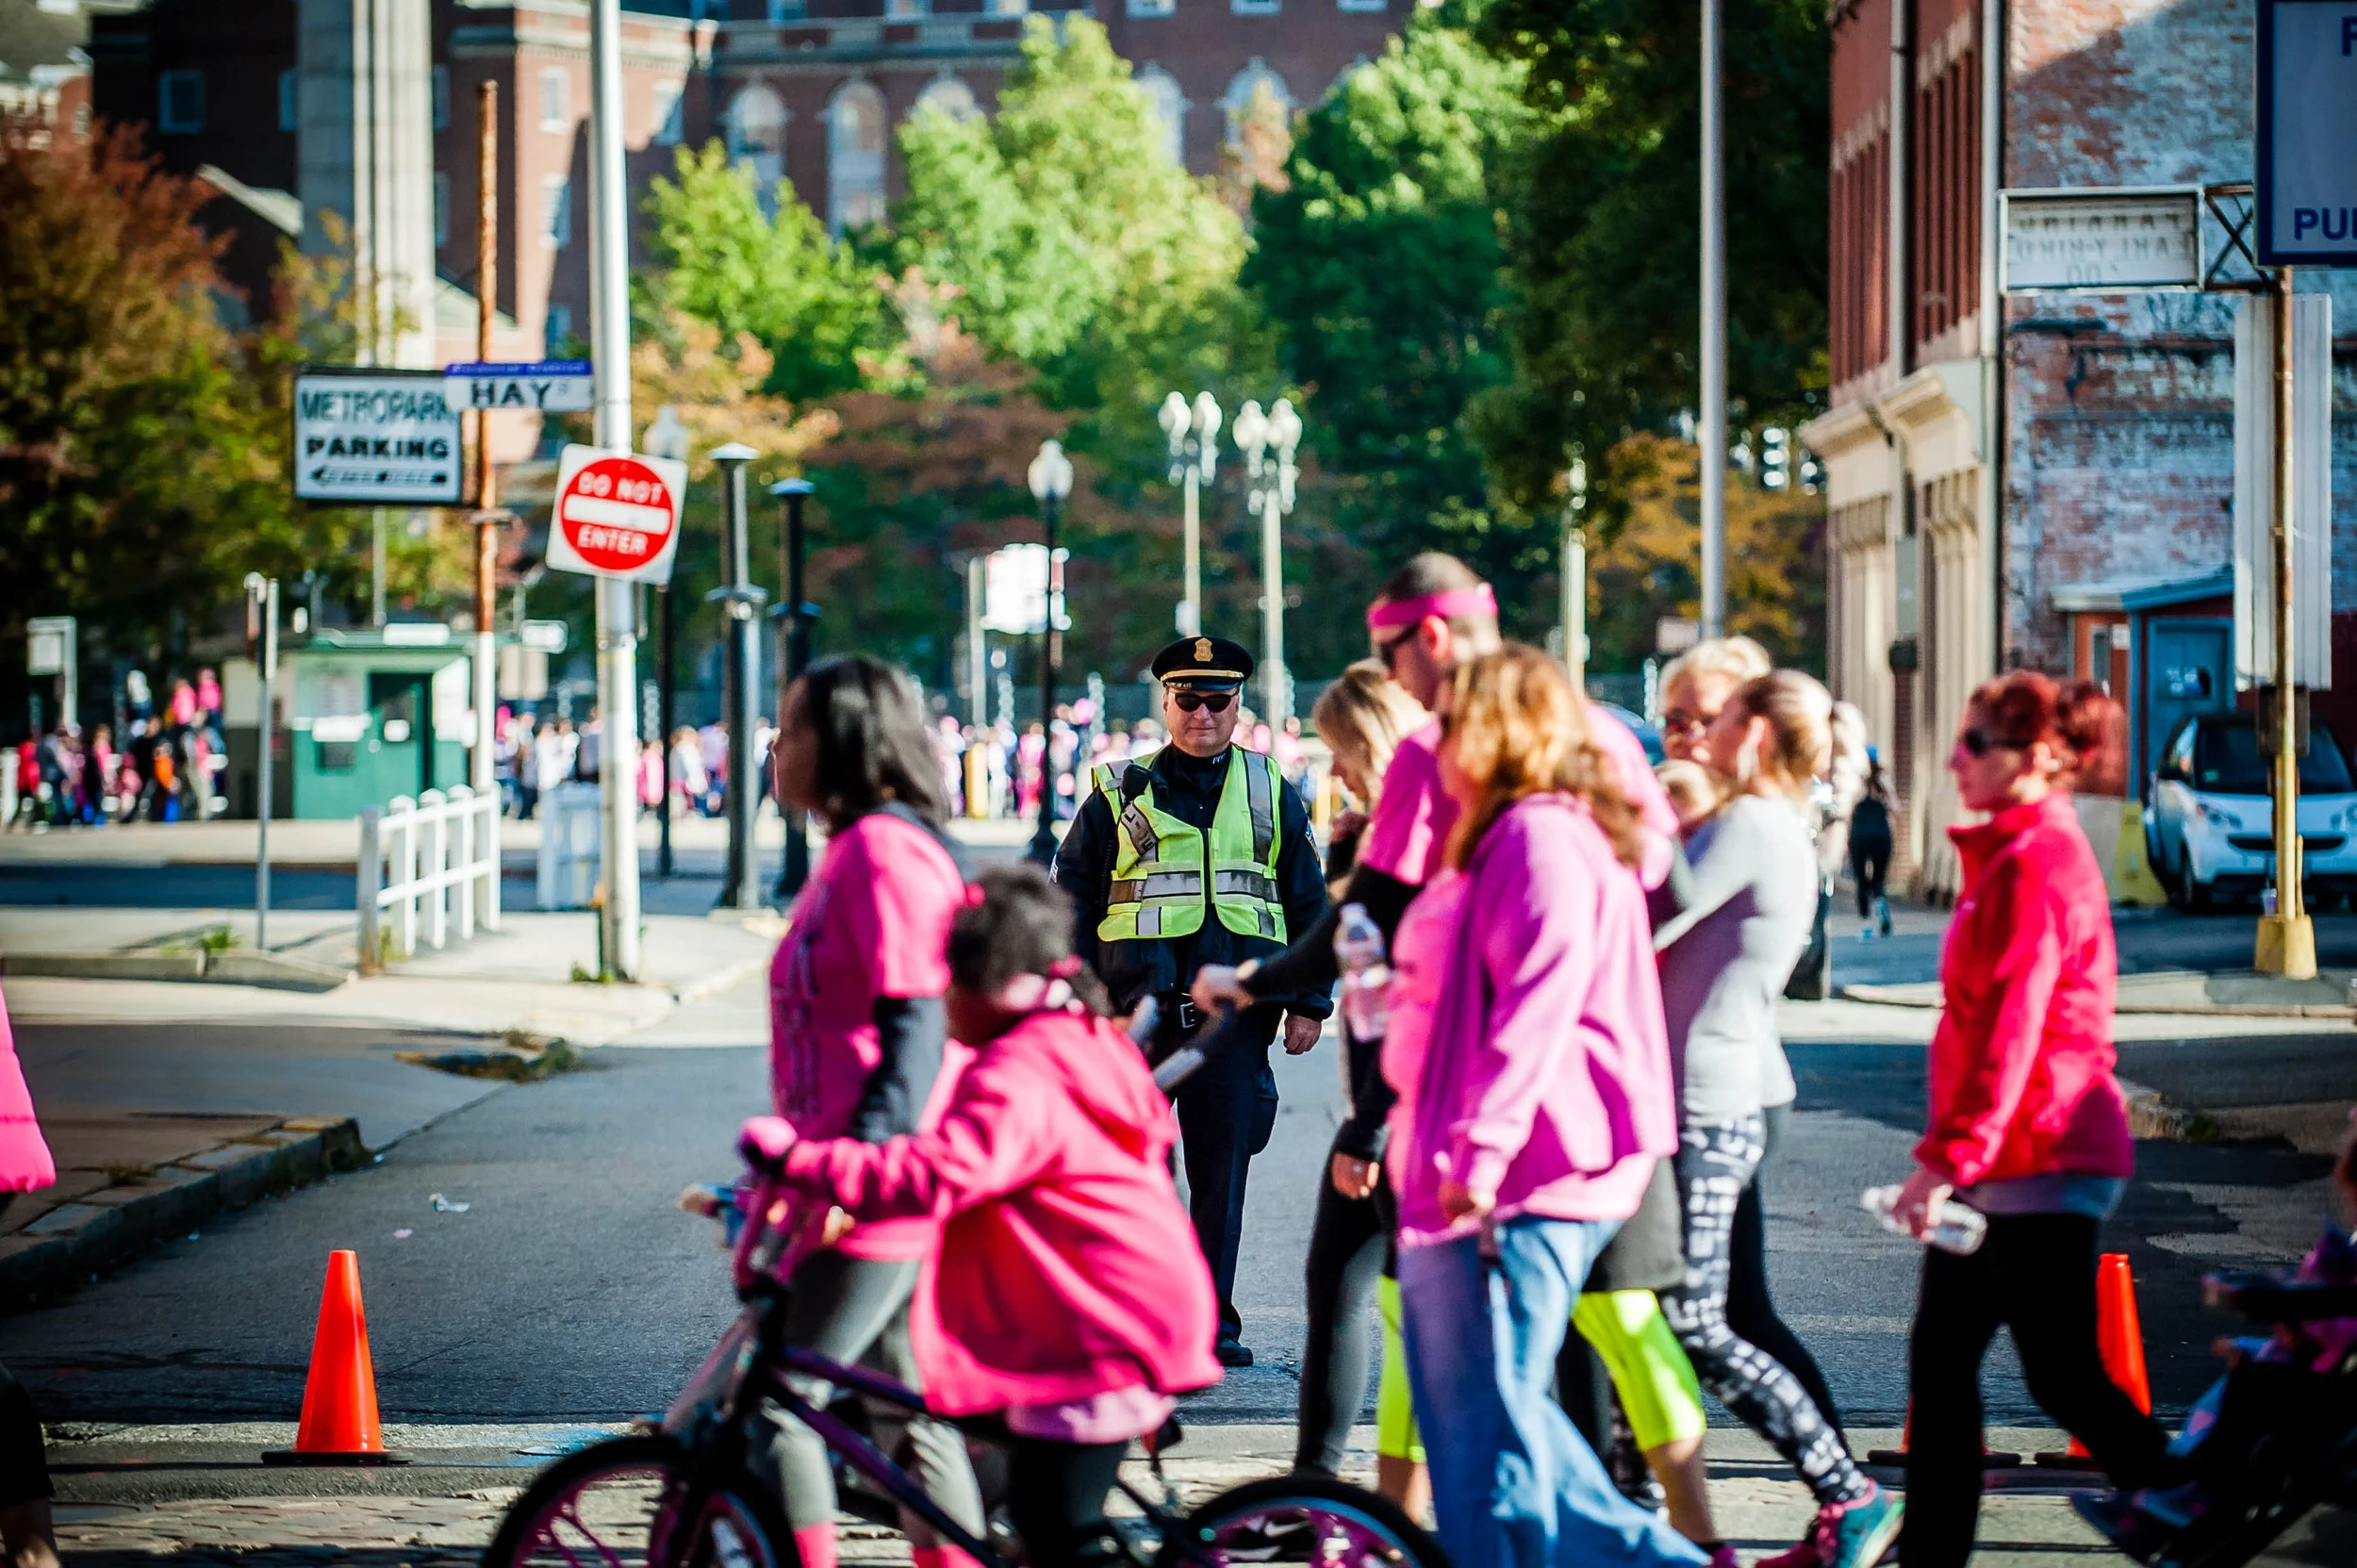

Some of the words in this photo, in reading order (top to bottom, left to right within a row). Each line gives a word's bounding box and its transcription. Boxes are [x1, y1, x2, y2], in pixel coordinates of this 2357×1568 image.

[2293, 206, 2357, 241] PU
[471, 380, 552, 408] HAY
[306, 437, 449, 459] PARKING
[578, 471, 612, 497] DO
[617, 477, 664, 505] NOT
[577, 524, 648, 555] ENTER
